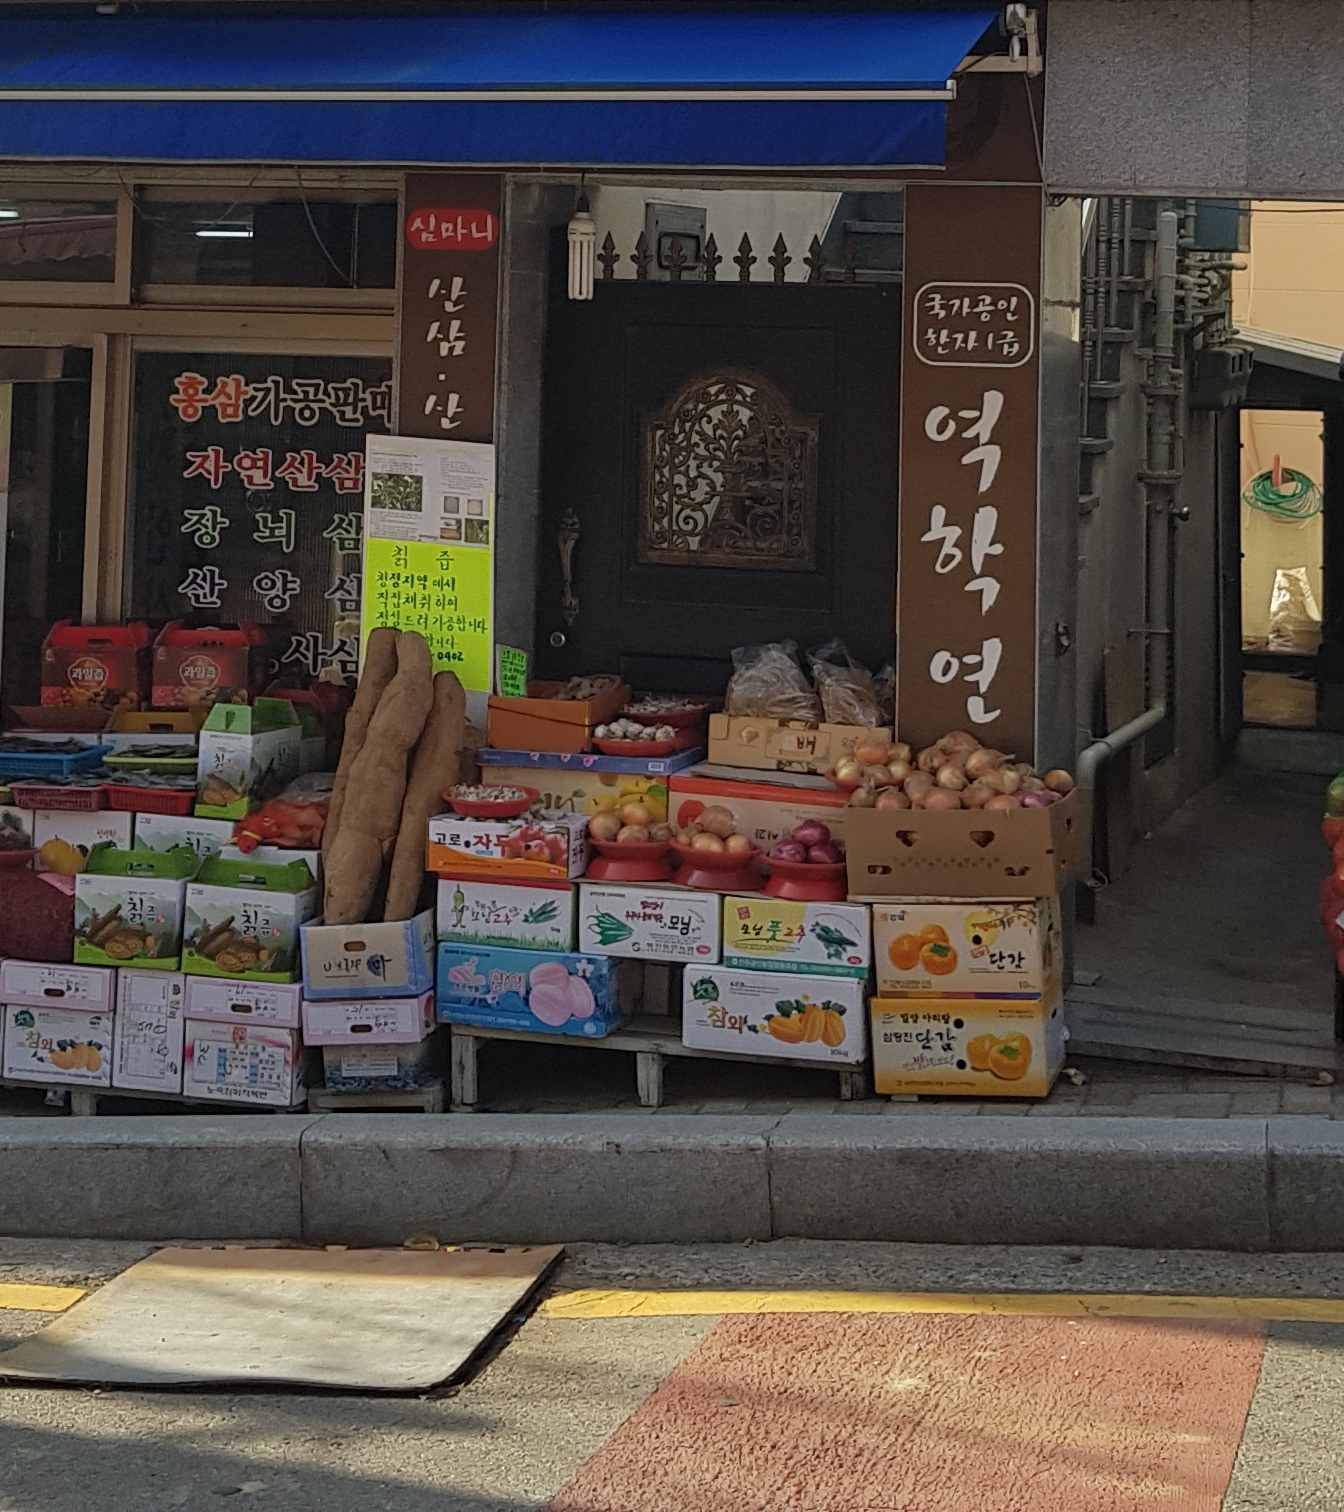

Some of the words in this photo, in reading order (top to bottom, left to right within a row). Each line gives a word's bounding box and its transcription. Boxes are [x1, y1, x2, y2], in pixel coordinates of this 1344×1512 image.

[410, 213, 494, 245] 심마니
[923, 292, 1019, 322] 국가공인
[923, 328, 979, 356] 한자
[920, 389, 1005, 724] 역학연
[989, 950, 1026, 970] 단감
[707, 1005, 743, 1034] 참외
